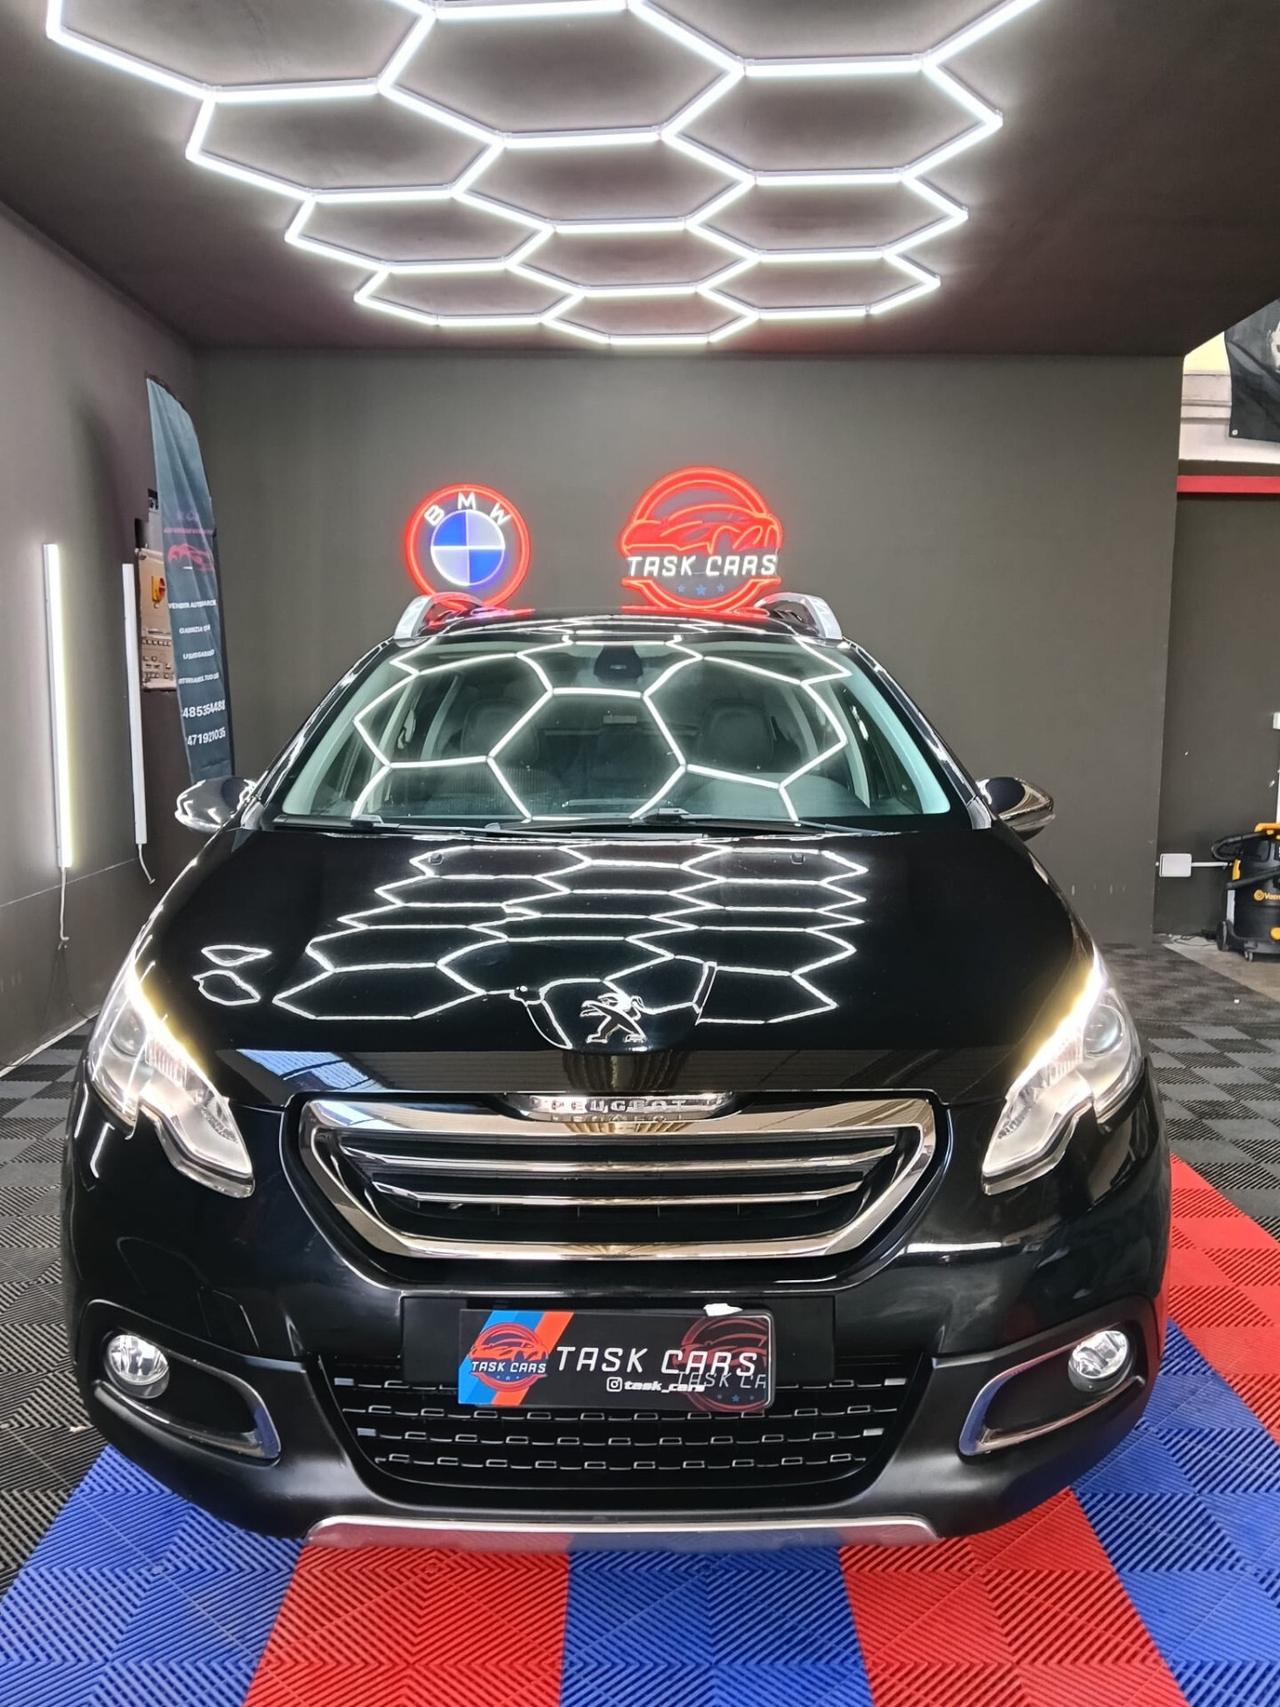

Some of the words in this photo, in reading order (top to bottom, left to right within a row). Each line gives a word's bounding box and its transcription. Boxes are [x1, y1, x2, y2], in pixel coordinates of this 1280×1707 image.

[424, 491, 511, 527] BMW
[627, 556, 697, 577] TASK
[705, 555, 778, 577] CARS
[472, 1361, 506, 1372] TASK
[510, 1362, 547, 1374] CARS
[556, 1346, 648, 1373] TASK
[661, 1350, 758, 1377] CARS
[624, 1380, 706, 1393] task_cars
